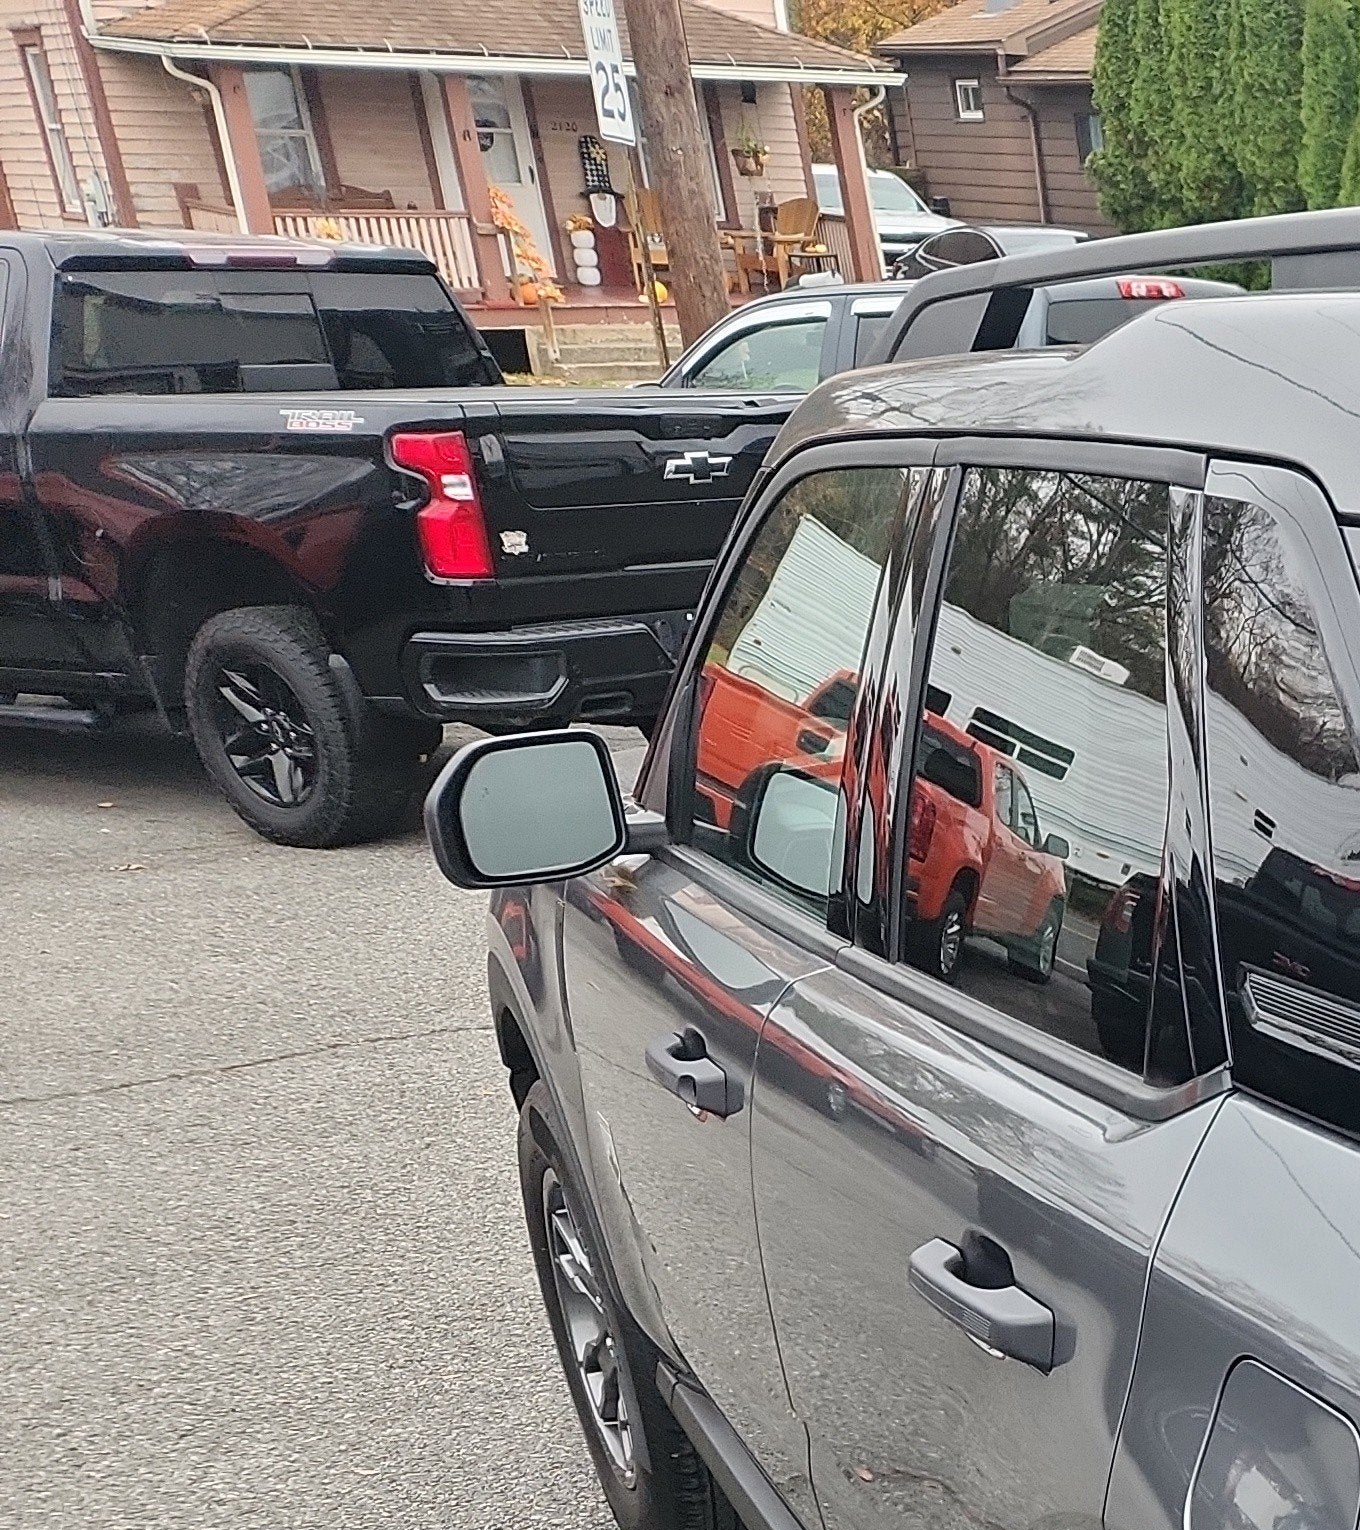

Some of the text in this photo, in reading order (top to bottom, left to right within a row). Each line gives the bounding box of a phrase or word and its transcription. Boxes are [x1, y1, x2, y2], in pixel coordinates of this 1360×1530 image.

[589, 26, 614, 53] LIMIT
[595, 61, 626, 122] 25
[279, 409, 365, 423] TRAIL
[286, 419, 352, 431] BOSS
